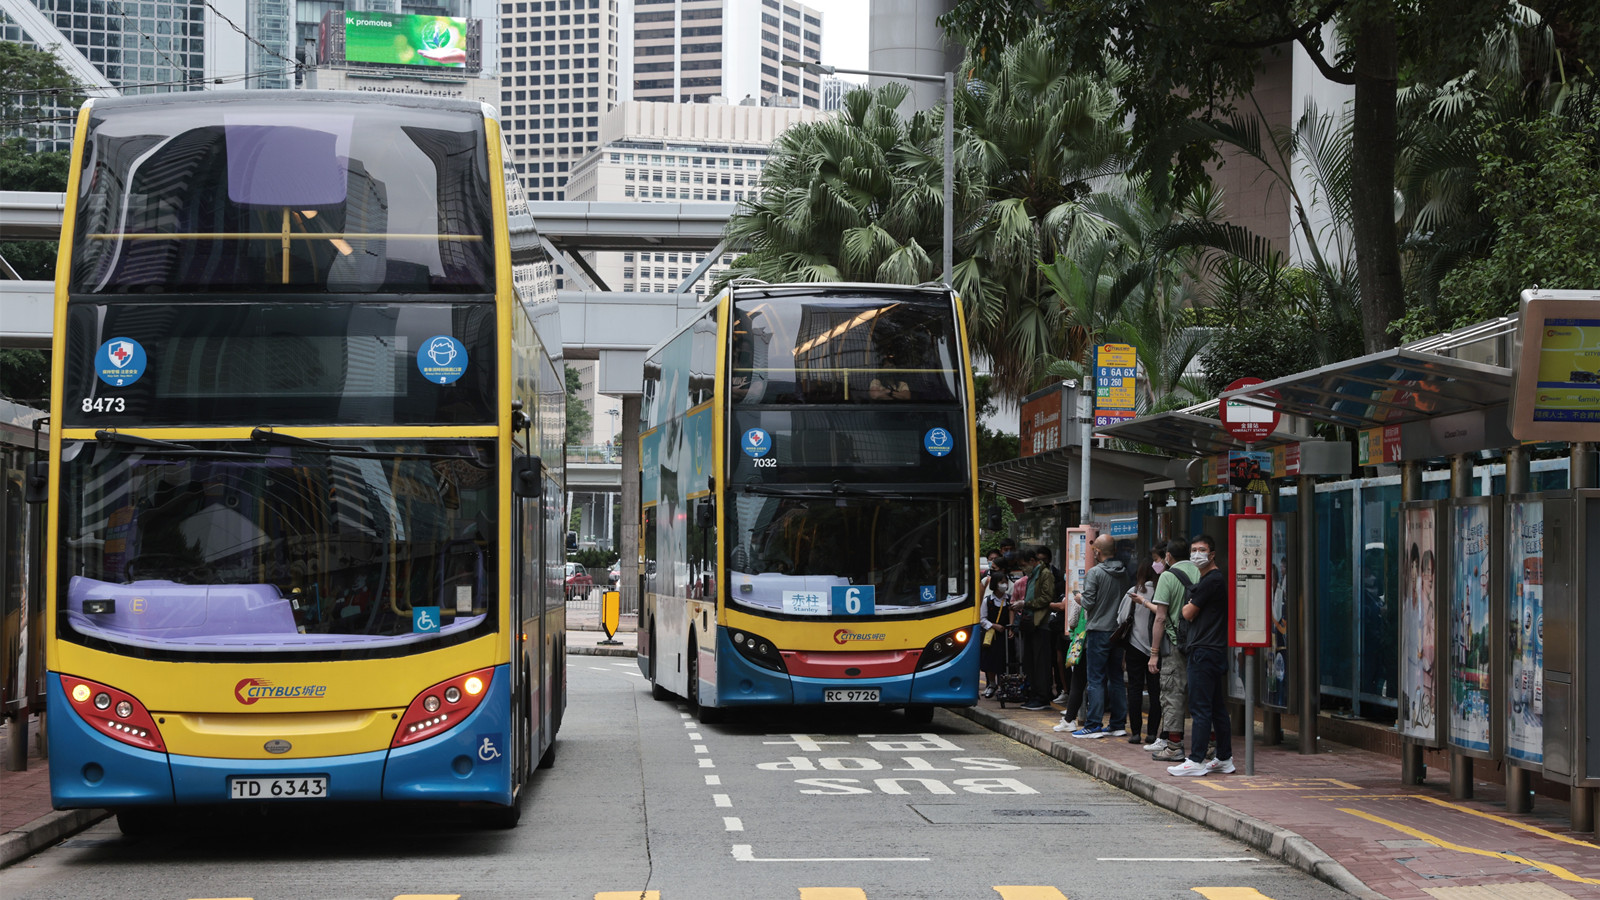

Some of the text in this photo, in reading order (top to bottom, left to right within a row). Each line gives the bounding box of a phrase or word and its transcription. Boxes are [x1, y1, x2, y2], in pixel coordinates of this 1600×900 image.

[356, 19, 393, 28] promotes
[1101, 368, 1135, 377] 6 6A 6X
[1098, 378, 1122, 387] 10 260
[81, 397, 126, 413] 8473
[1097, 417, 1107, 425] 66
[752, 458, 777, 468] 7032
[133, 598, 144, 612] E
[791, 594, 820, 607] 赤柱
[845, 587, 861, 614] 6
[247, 685, 327, 697] CITYBUS 城巴
[827, 691, 877, 701] RC 9726
[756, 757, 1022, 771] STOP
[235, 780, 323, 797] TD 6343
[794, 778, 1041, 795] BUS
